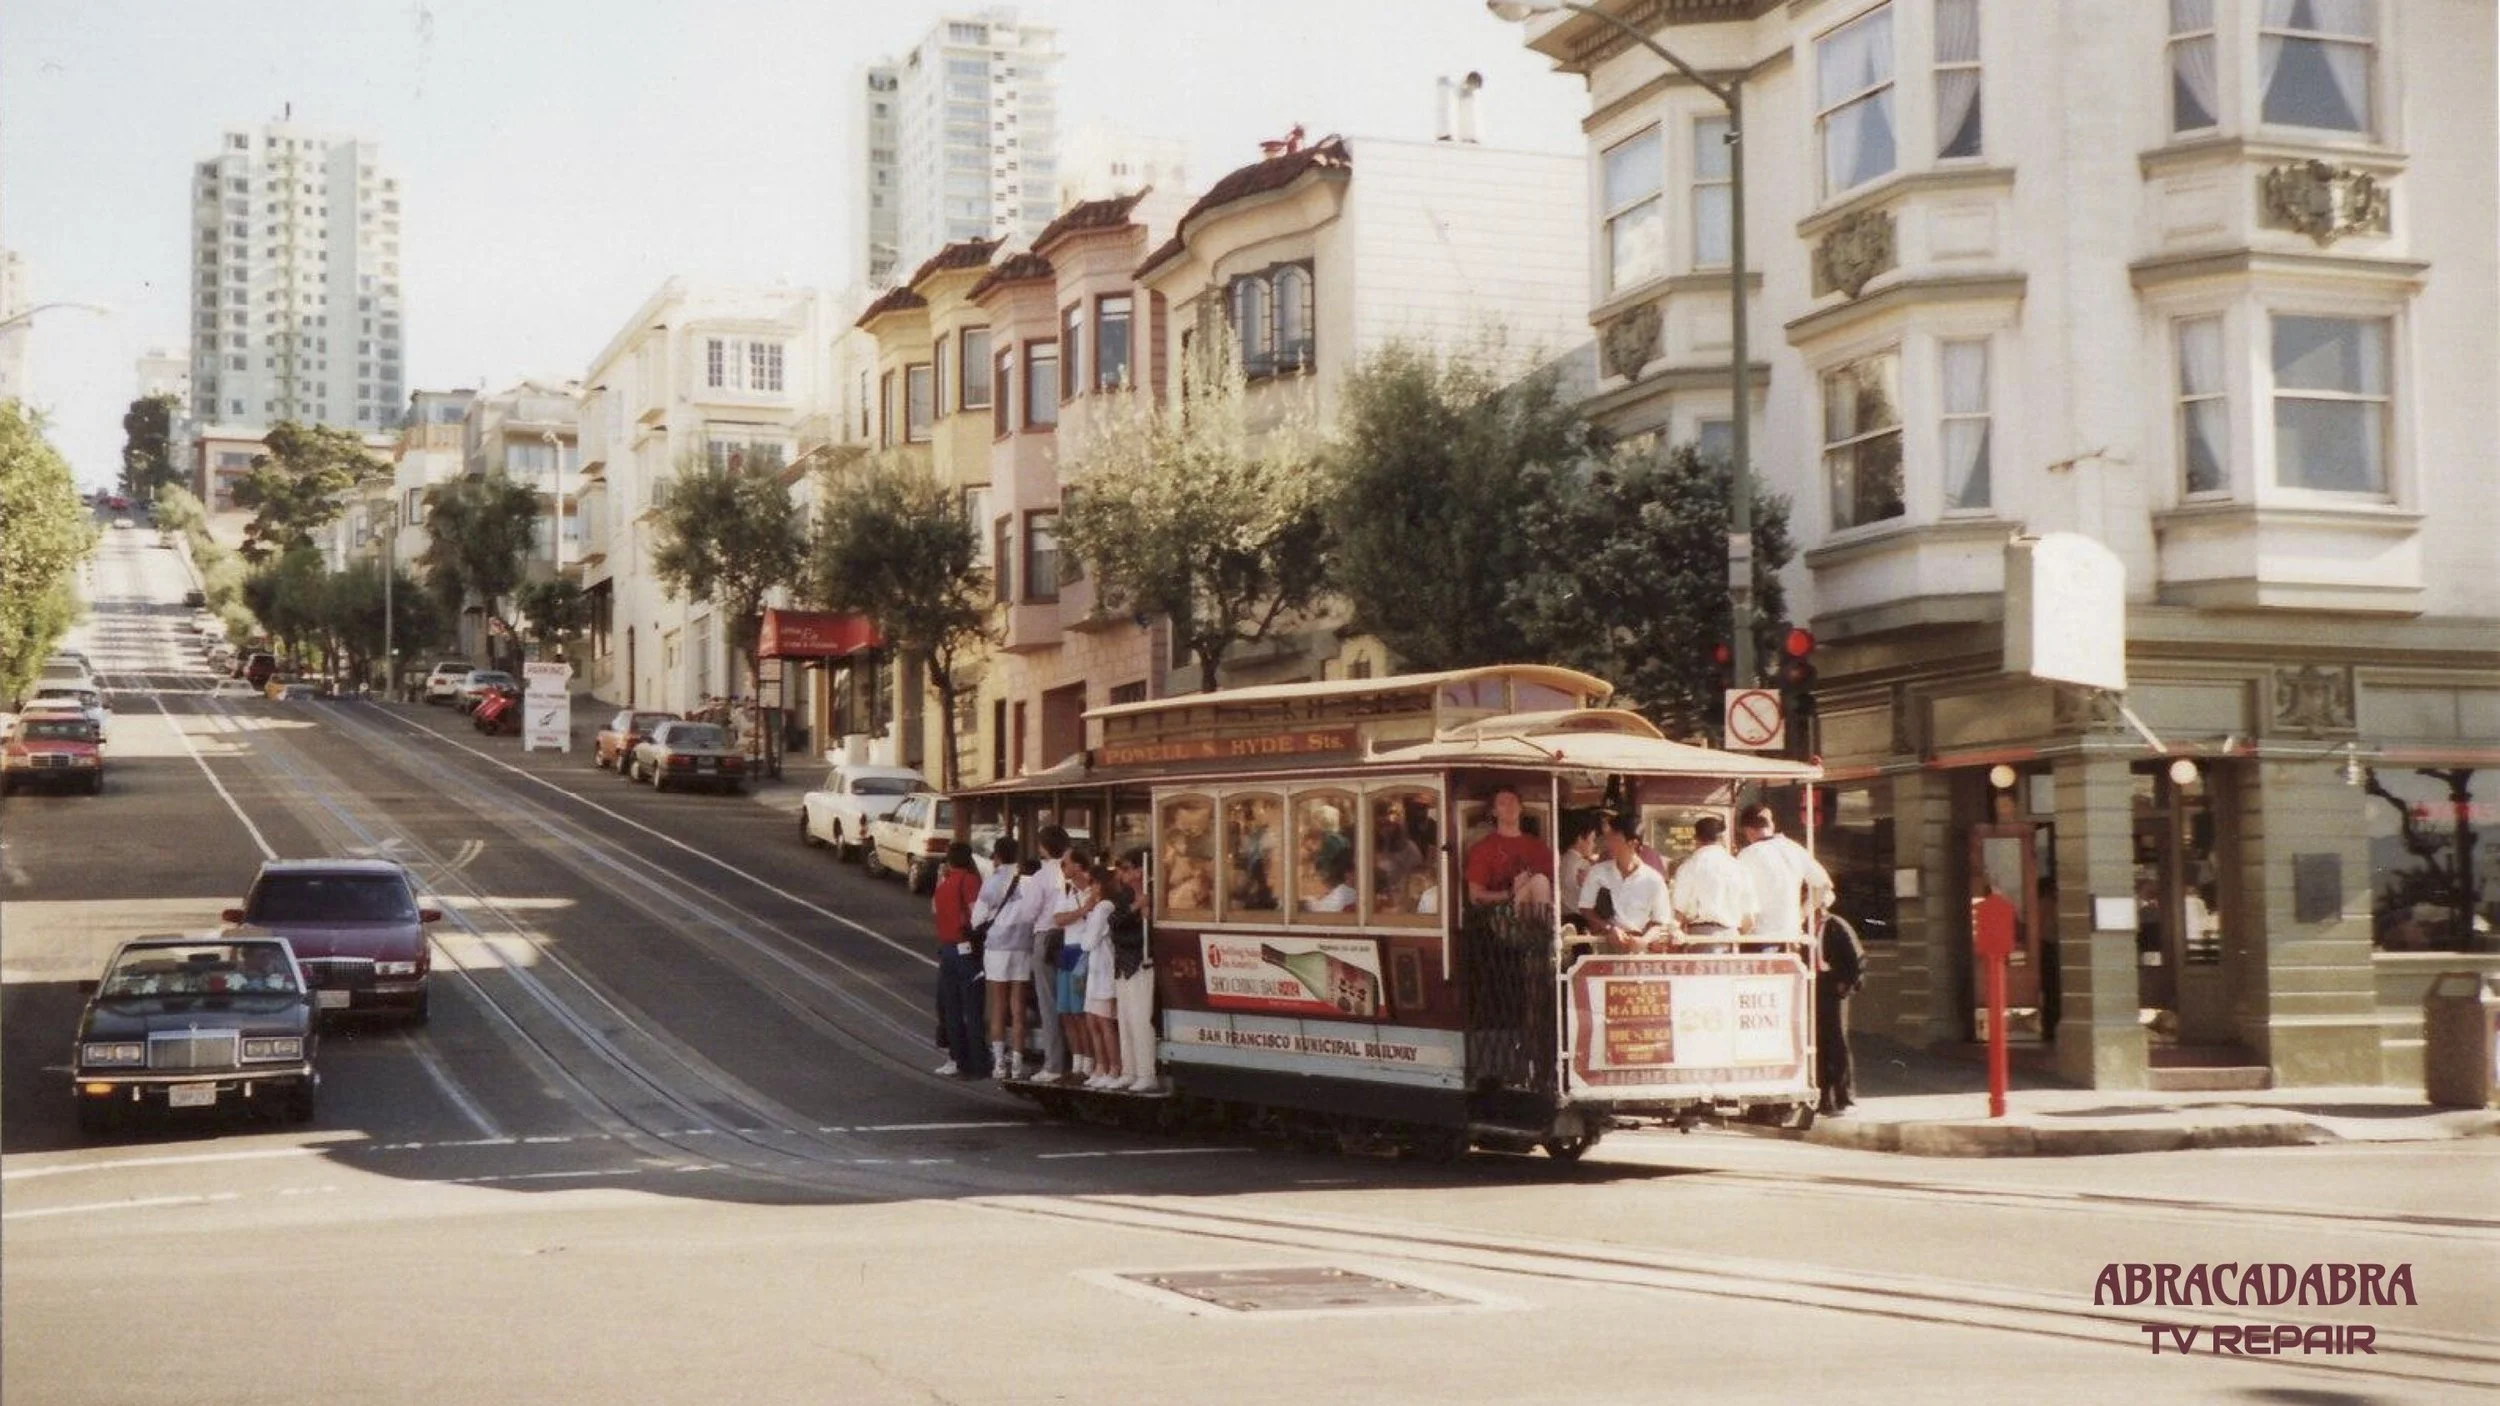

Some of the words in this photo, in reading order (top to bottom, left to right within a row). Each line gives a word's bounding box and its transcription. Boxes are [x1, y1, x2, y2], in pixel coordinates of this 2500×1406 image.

[1105, 744, 1189, 765] POWELL
[1231, 736, 1294, 756] HYDE
[1308, 733, 1344, 751] Sts.
[1612, 960, 1688, 975] MARKET
[1609, 984, 1668, 997] POWELL
[1738, 992, 1777, 1009] RICE
[1198, 1028, 1221, 1043] SAN
[1225, 1031, 1290, 1049] FRANCISCO
[1294, 1036, 1361, 1056] MUNICIPAL
[1364, 1043, 1418, 1061] RAILWAY
